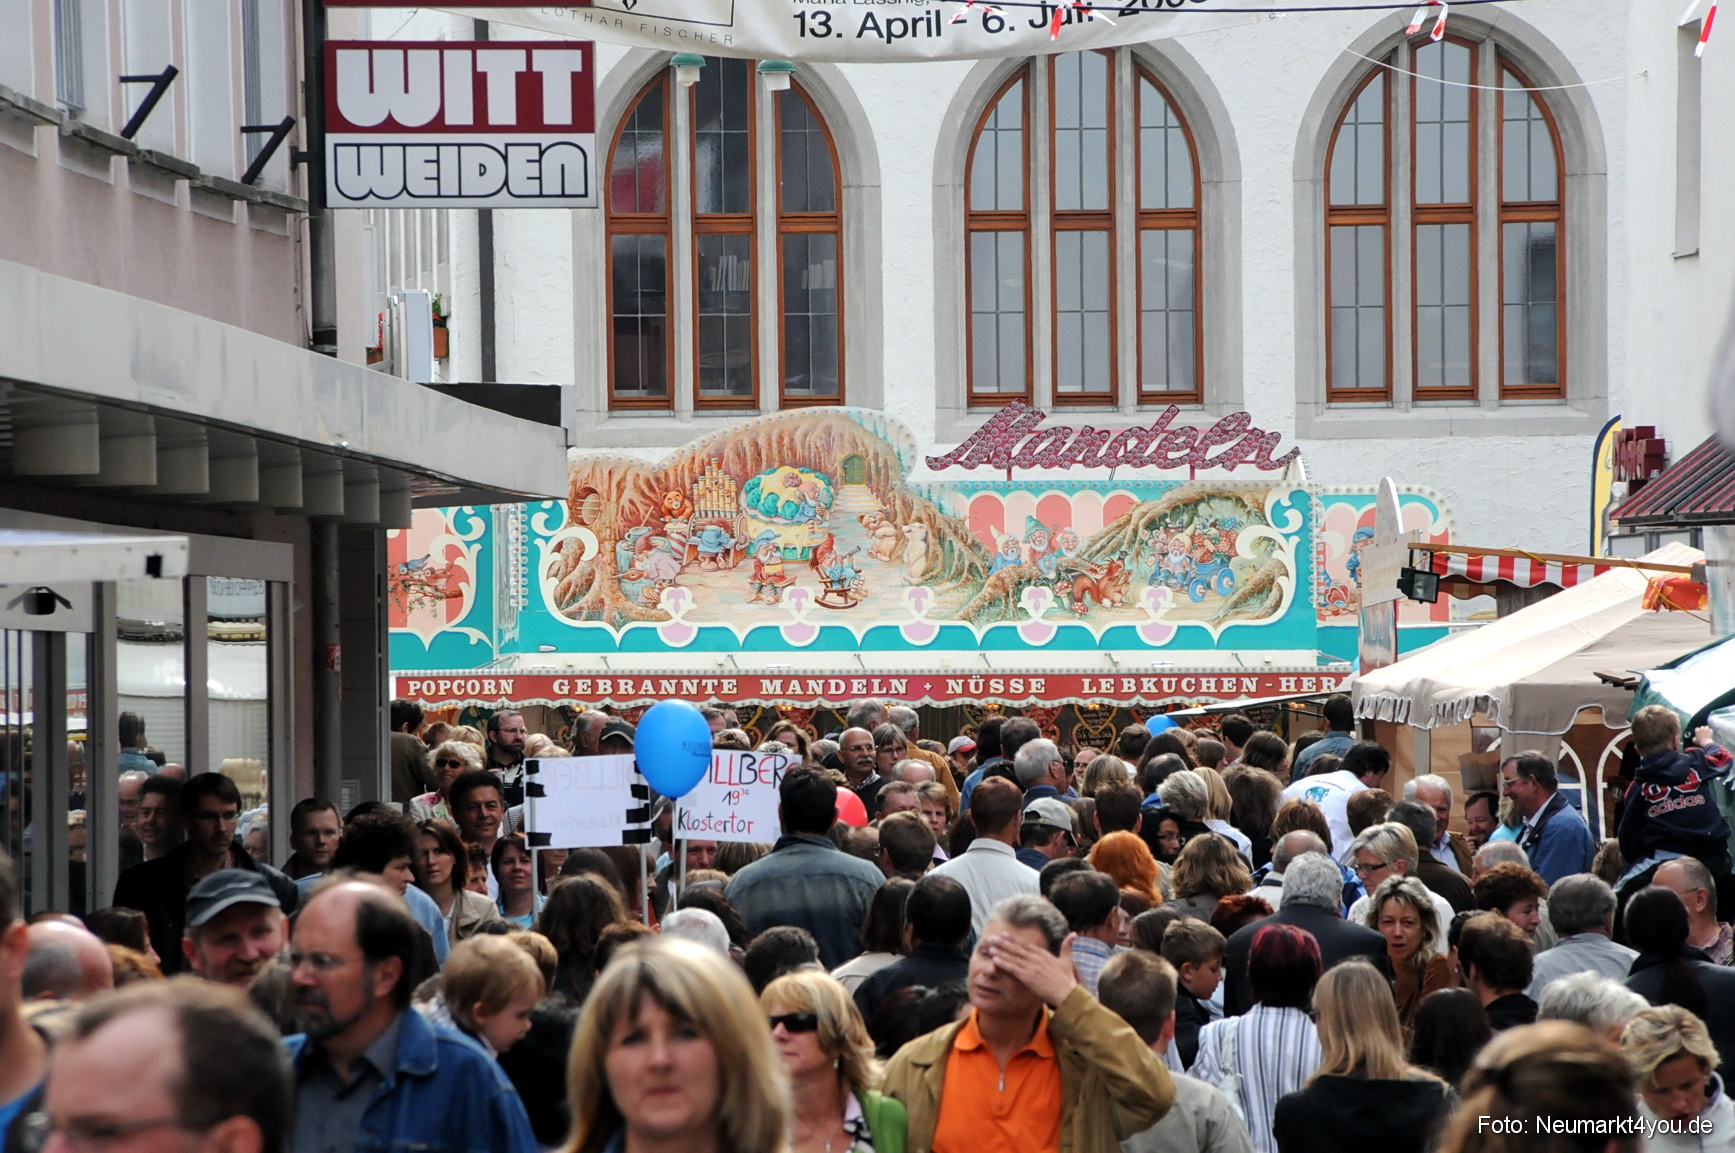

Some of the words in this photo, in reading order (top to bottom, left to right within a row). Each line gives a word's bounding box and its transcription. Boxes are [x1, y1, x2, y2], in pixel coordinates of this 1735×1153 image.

[541, 7, 624, 28] LOTHAR
[640, 23, 733, 45] FISCHER
[793, 10, 843, 38] 13.
[856, 9, 942, 44] April
[982, 5, 1015, 34] 6.
[336, 49, 583, 127] WITT
[334, 141, 588, 200] WEIDEN
[925, 398, 1301, 470] Mandeln
[408, 679, 514, 696] POPCORN
[552, 679, 738, 696] GEBRANNTE
[760, 678, 908, 695] MANDELN
[946, 675, 1047, 694] NÜSSE
[709, 753, 797, 788] ILLBER
[678, 807, 754, 834] Klostertor
[1648, 794, 1706, 818] adidas
